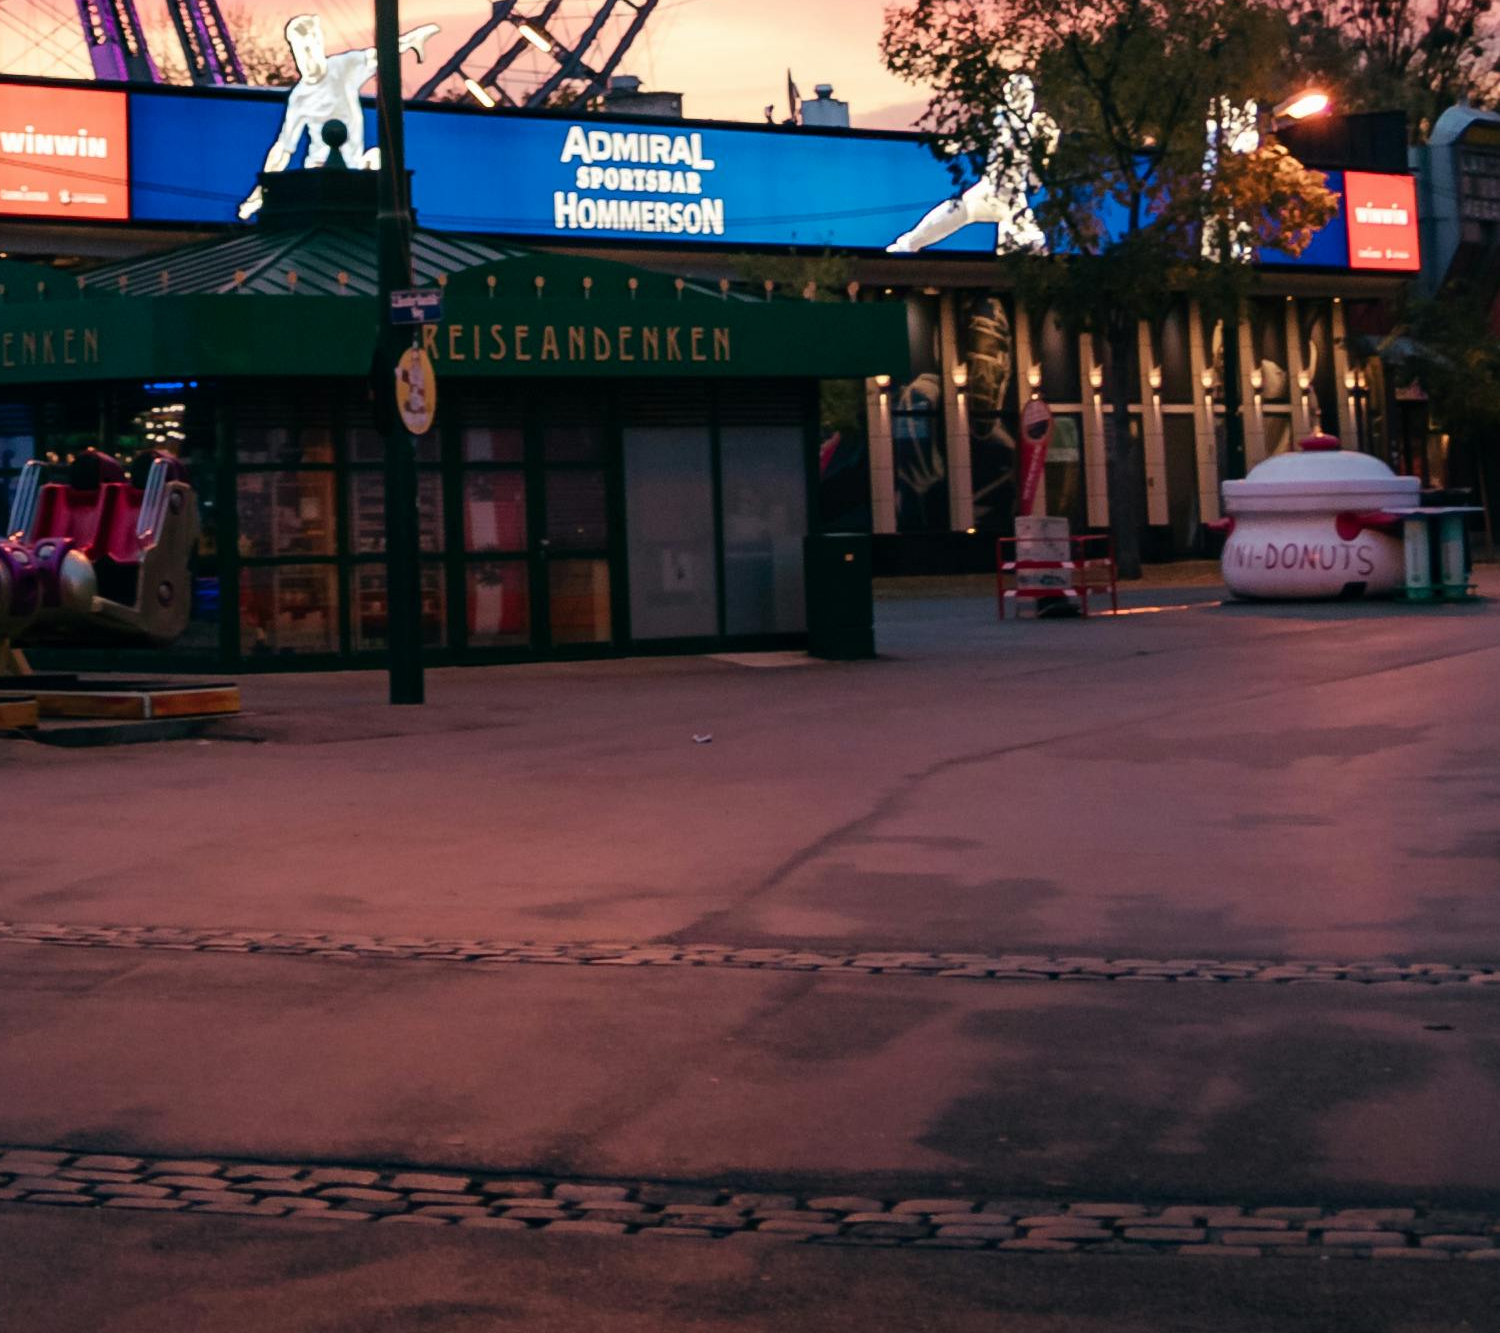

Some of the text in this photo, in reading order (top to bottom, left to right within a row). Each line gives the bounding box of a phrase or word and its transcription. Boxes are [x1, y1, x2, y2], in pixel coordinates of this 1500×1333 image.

[560, 125, 716, 171] ADMIRAL
[575, 166, 702, 194] SPORTSBAR
[554, 191, 725, 235] HOMMERSON
[421, 324, 731, 362] REISEANDENKEN
[1226, 542, 1375, 576] INI-DONUTS
